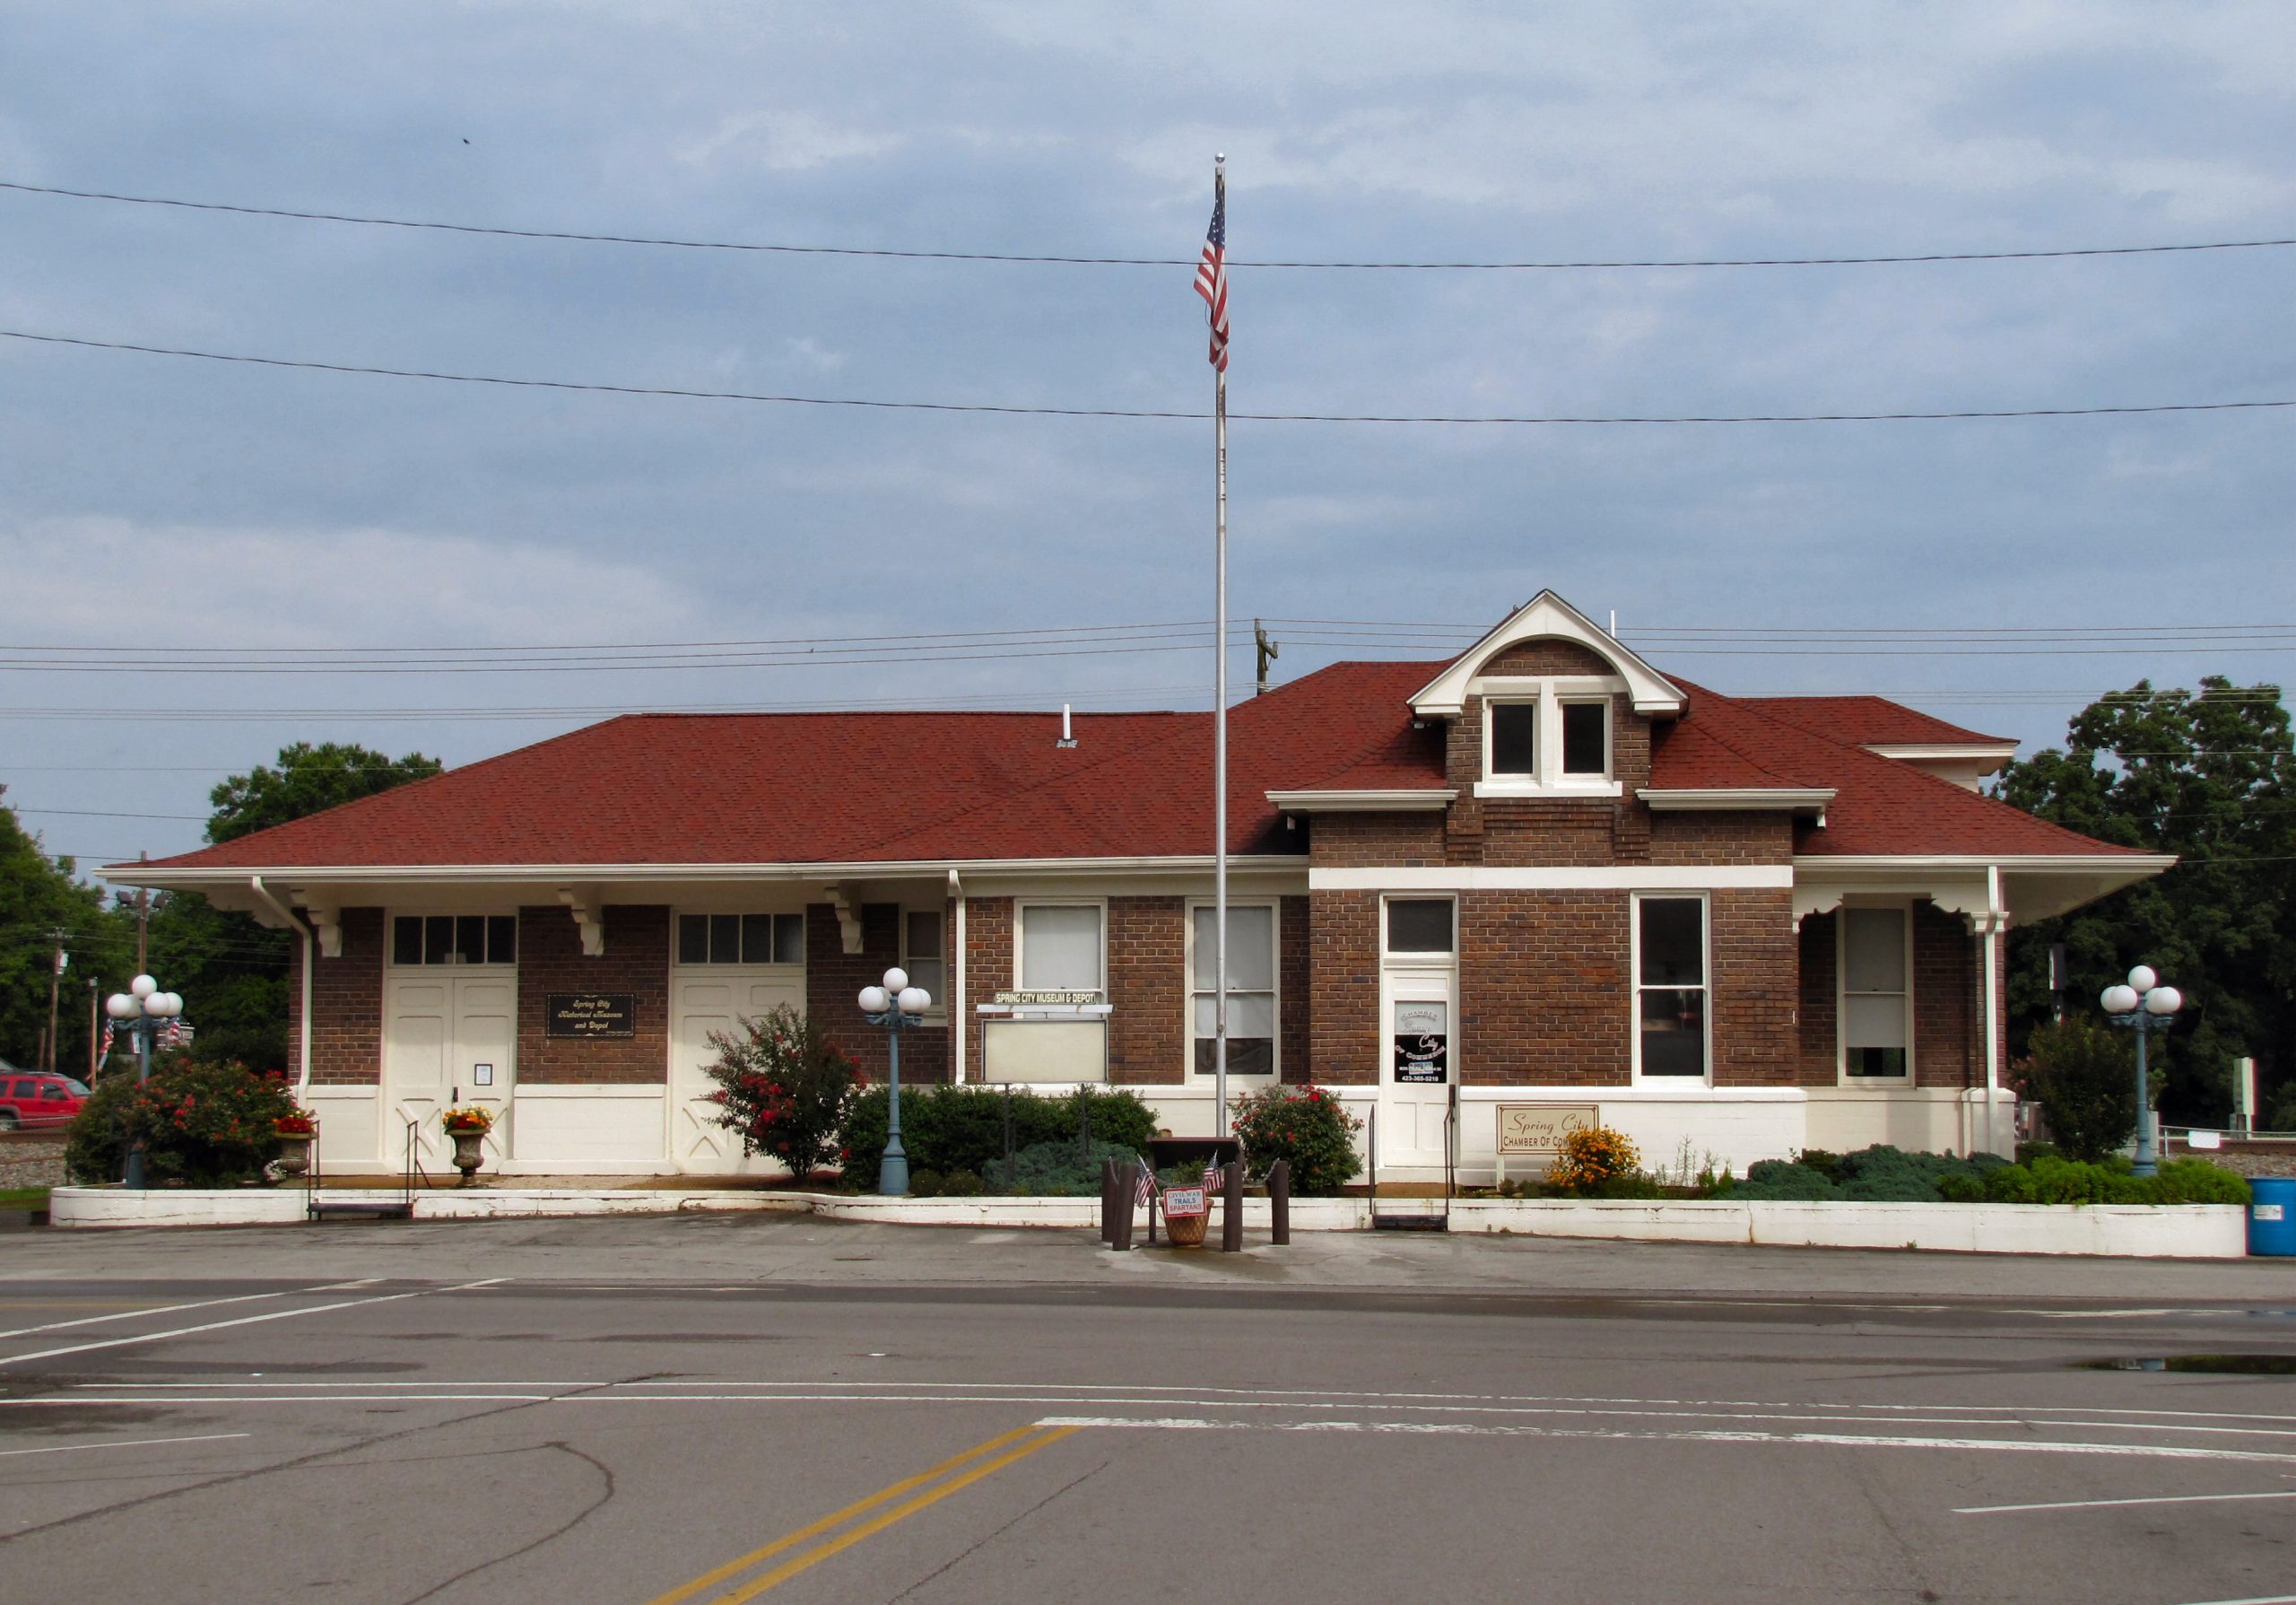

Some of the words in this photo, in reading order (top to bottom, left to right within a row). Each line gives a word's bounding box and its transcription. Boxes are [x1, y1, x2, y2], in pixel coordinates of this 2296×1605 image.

[996, 993, 1021, 1003] SPRING
[1022, 993, 1035, 1003] CITY
[1037, 993, 1065, 1003] MUSEUM
[1066, 993, 1072, 1003] &
[1073, 993, 1093, 1003] DEPOT
[1419, 1034, 1439, 1051] City
[1508, 1113, 1553, 1135] Spring
[1503, 1136, 1537, 1147] CHAMBER
